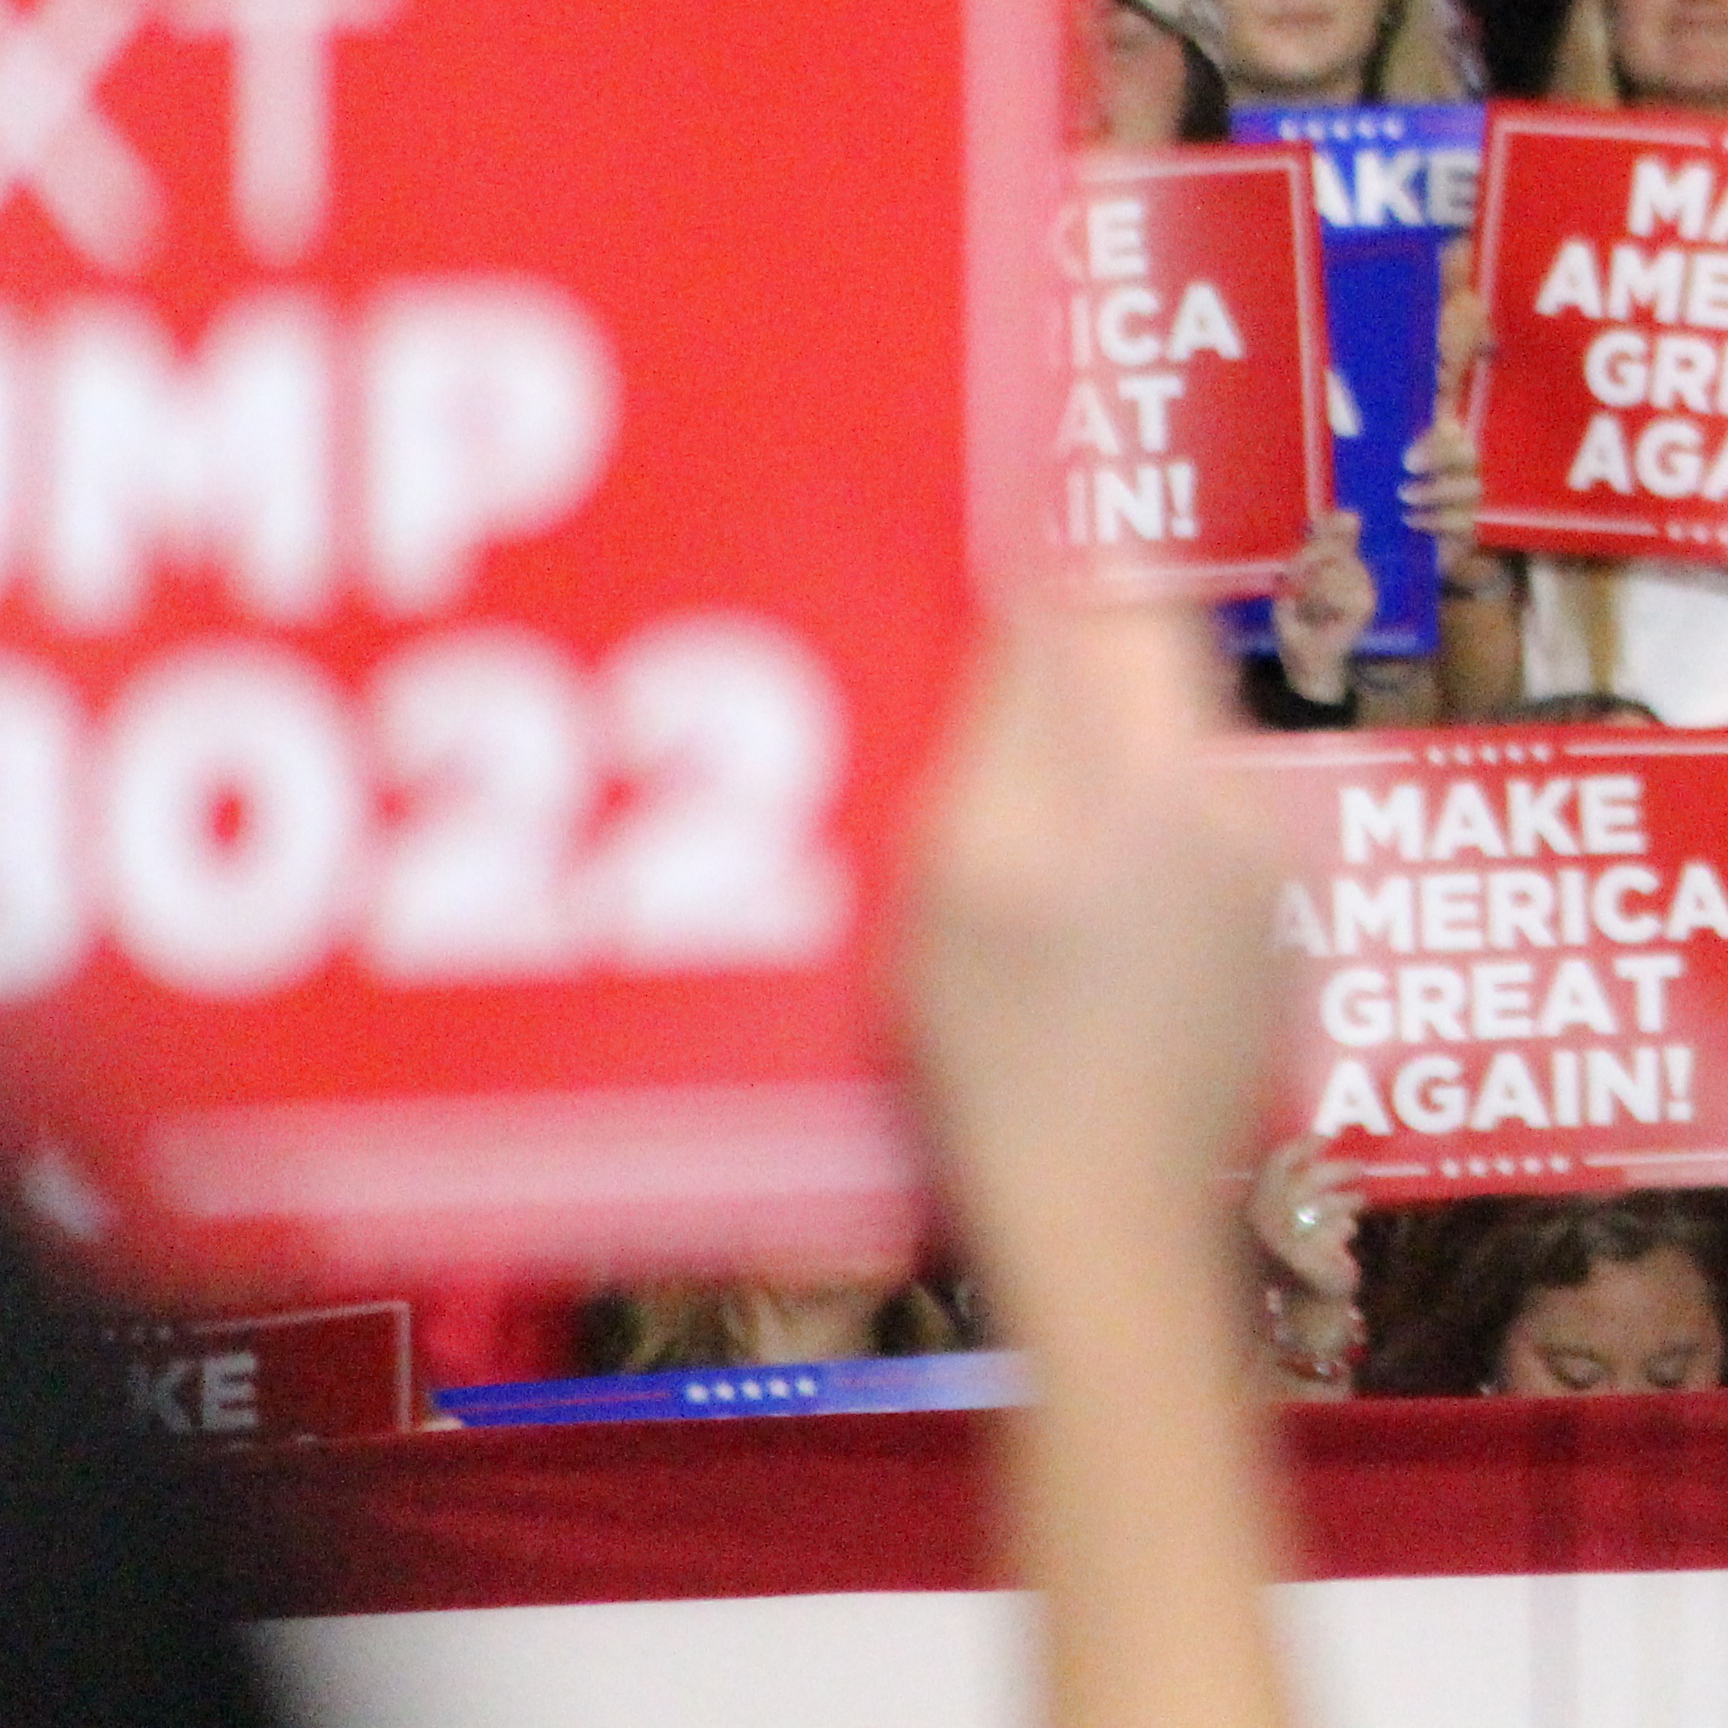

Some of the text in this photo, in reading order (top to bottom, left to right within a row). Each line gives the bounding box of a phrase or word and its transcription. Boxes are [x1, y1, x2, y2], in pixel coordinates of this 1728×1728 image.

[1312, 151, 1477, 229] AKE
[1339, 775, 1647, 865] MAKE
[1320, 953, 1684, 1047] GREAT
[1314, 1045, 1694, 1138] AGAIN!
